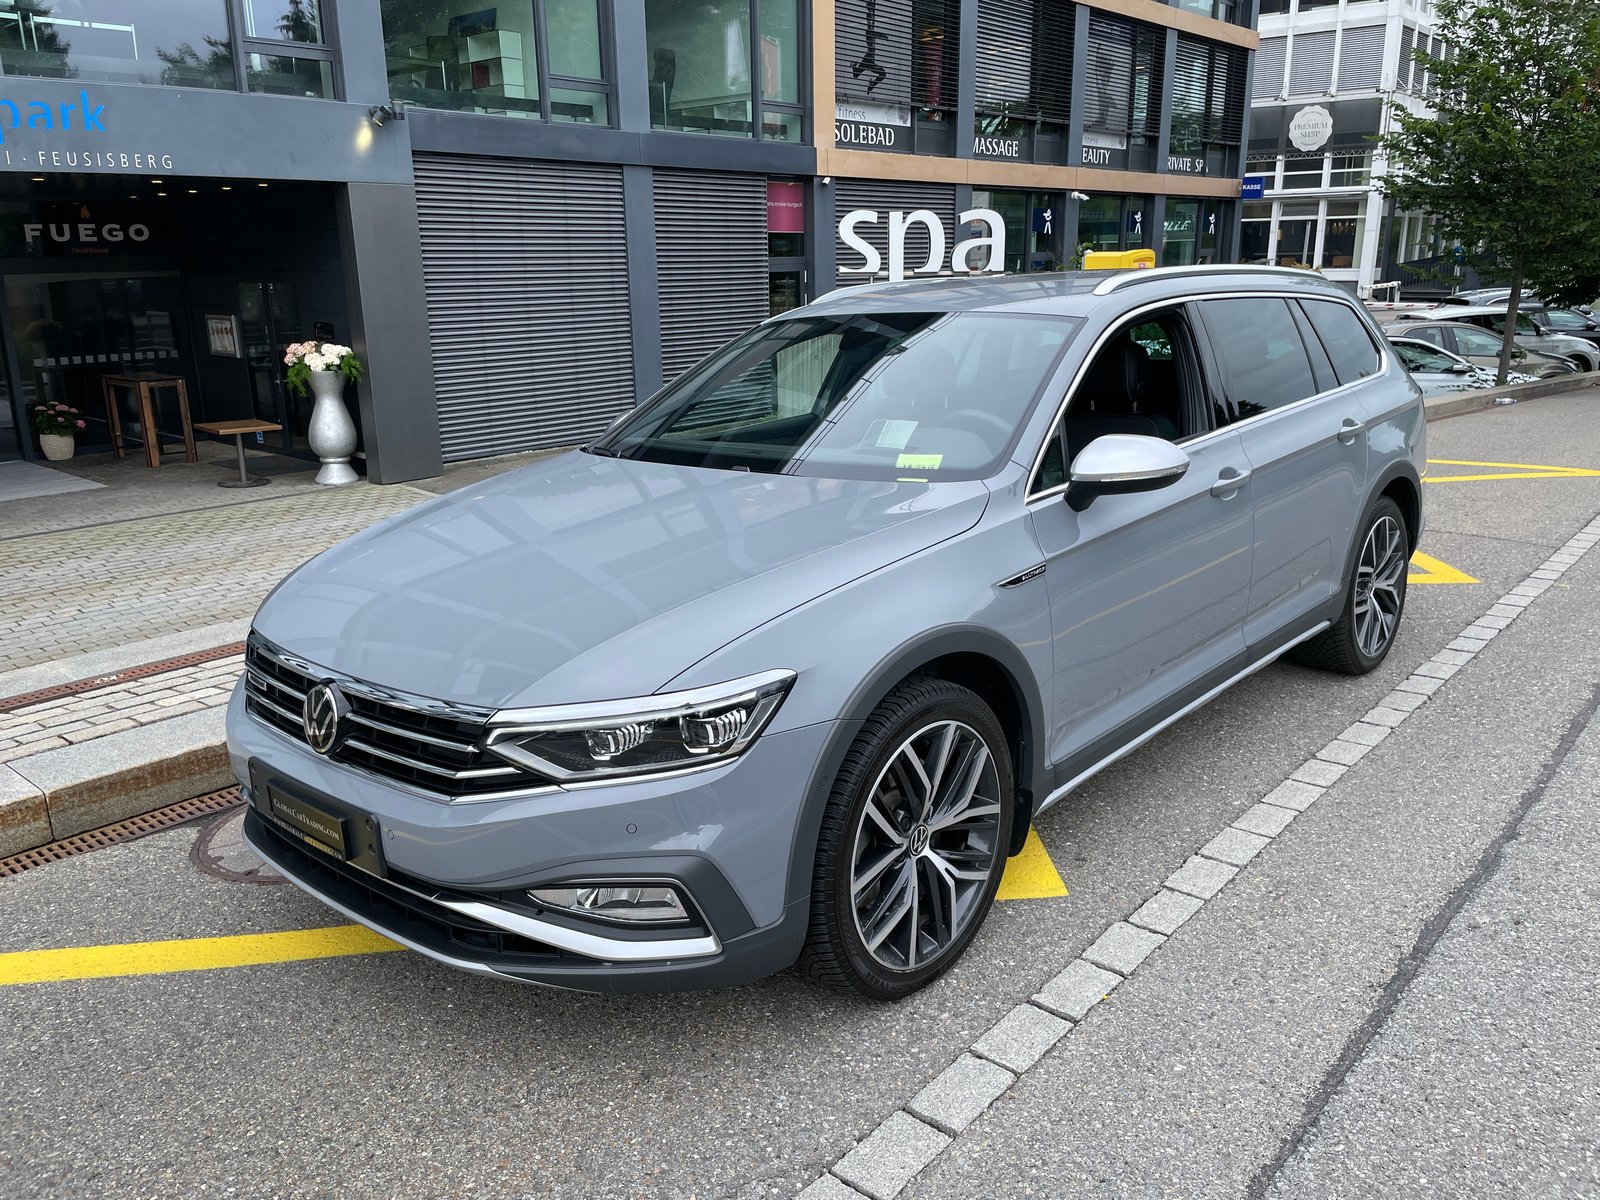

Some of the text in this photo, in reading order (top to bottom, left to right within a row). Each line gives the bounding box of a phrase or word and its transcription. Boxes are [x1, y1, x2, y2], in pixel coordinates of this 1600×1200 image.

[838, 104, 866, 120] fitness
[834, 122, 895, 146] SOLEBAD
[1293, 122, 1328, 131] PREMIUM
[38, 150, 173, 169] FEUSISBERG
[1082, 147, 1111, 165] EAUTY
[1167, 156, 1209, 173] RIVATE SP
[1242, 183, 1262, 191] KASSE
[23, 223, 150, 243] FUEGO
[838, 208, 1006, 282] spa
